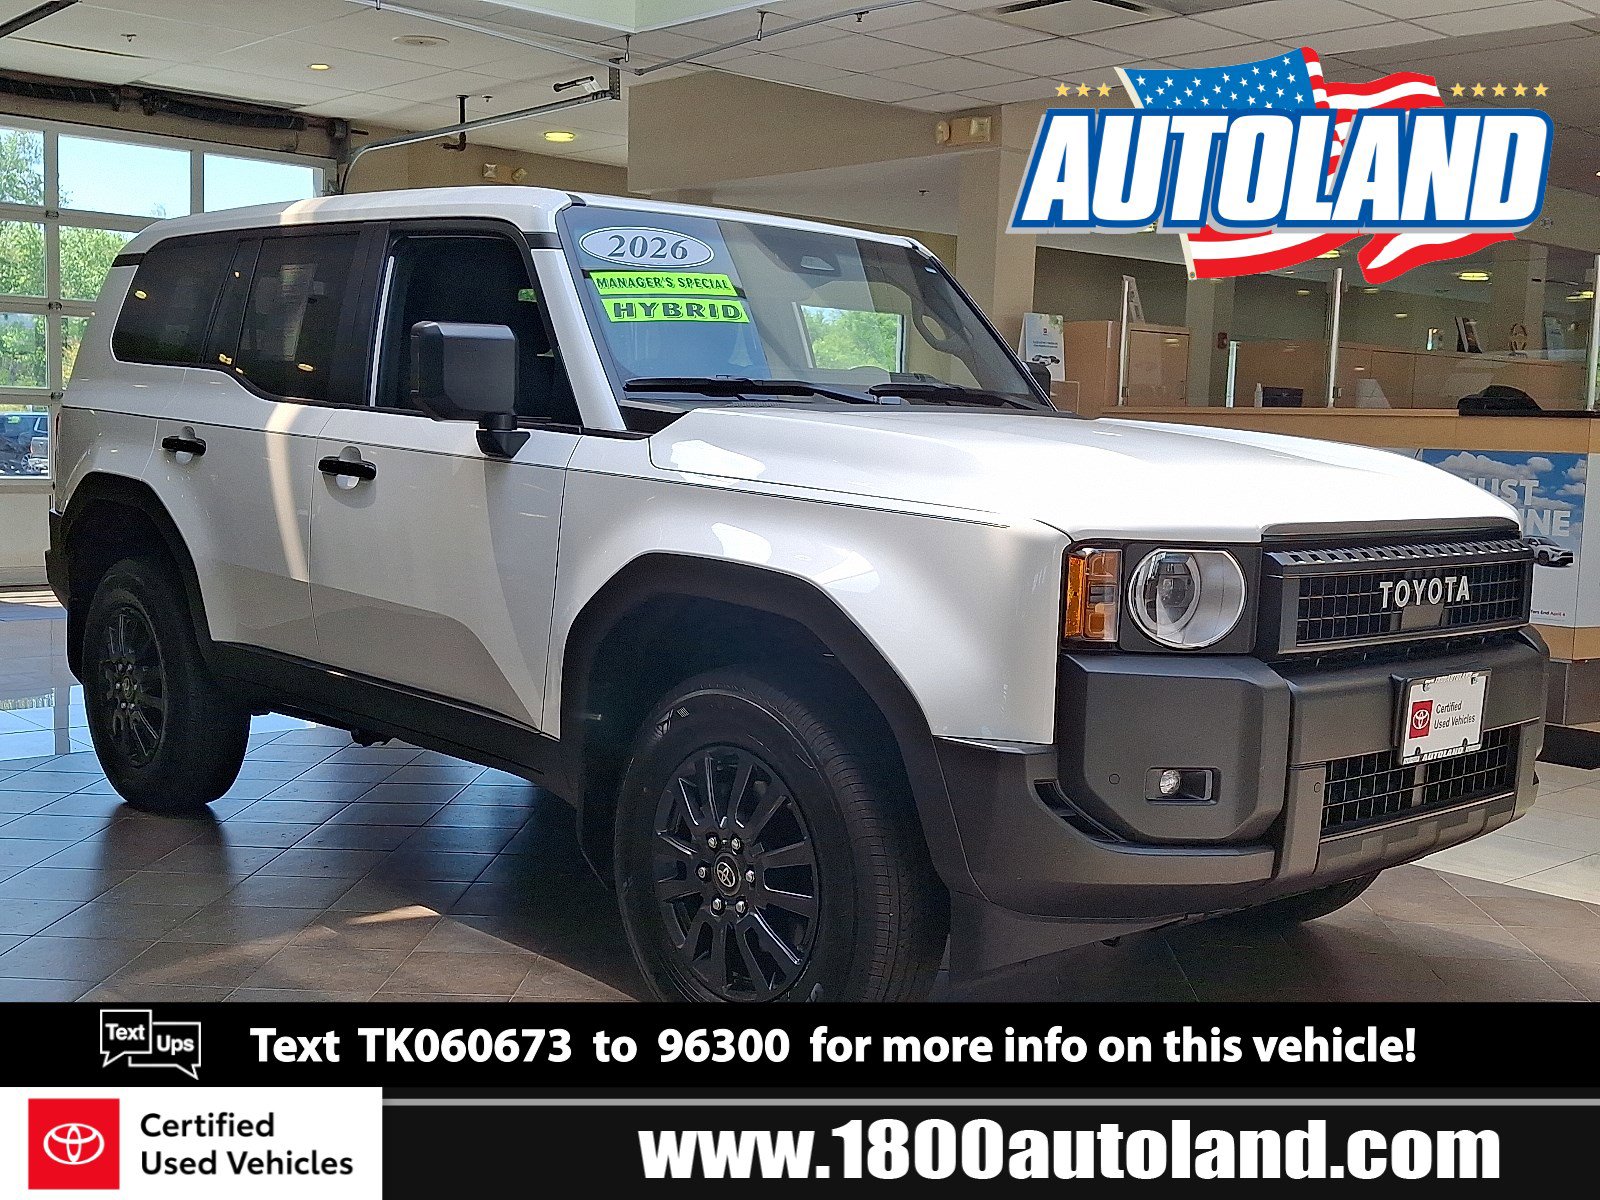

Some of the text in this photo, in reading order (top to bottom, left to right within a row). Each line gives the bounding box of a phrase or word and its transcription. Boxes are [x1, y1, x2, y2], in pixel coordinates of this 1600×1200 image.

[608, 235, 688, 260] 2026
[596, 276, 730, 290] MANAGER'S SPECIAL
[613, 302, 743, 320] HYBRID
[1379, 575, 1470, 609] TOYOTA
[1435, 700, 1462, 714] Certified
[1434, 714, 1476, 729] Used Vehicles
[1421, 747, 1465, 762] AUTOLAND
